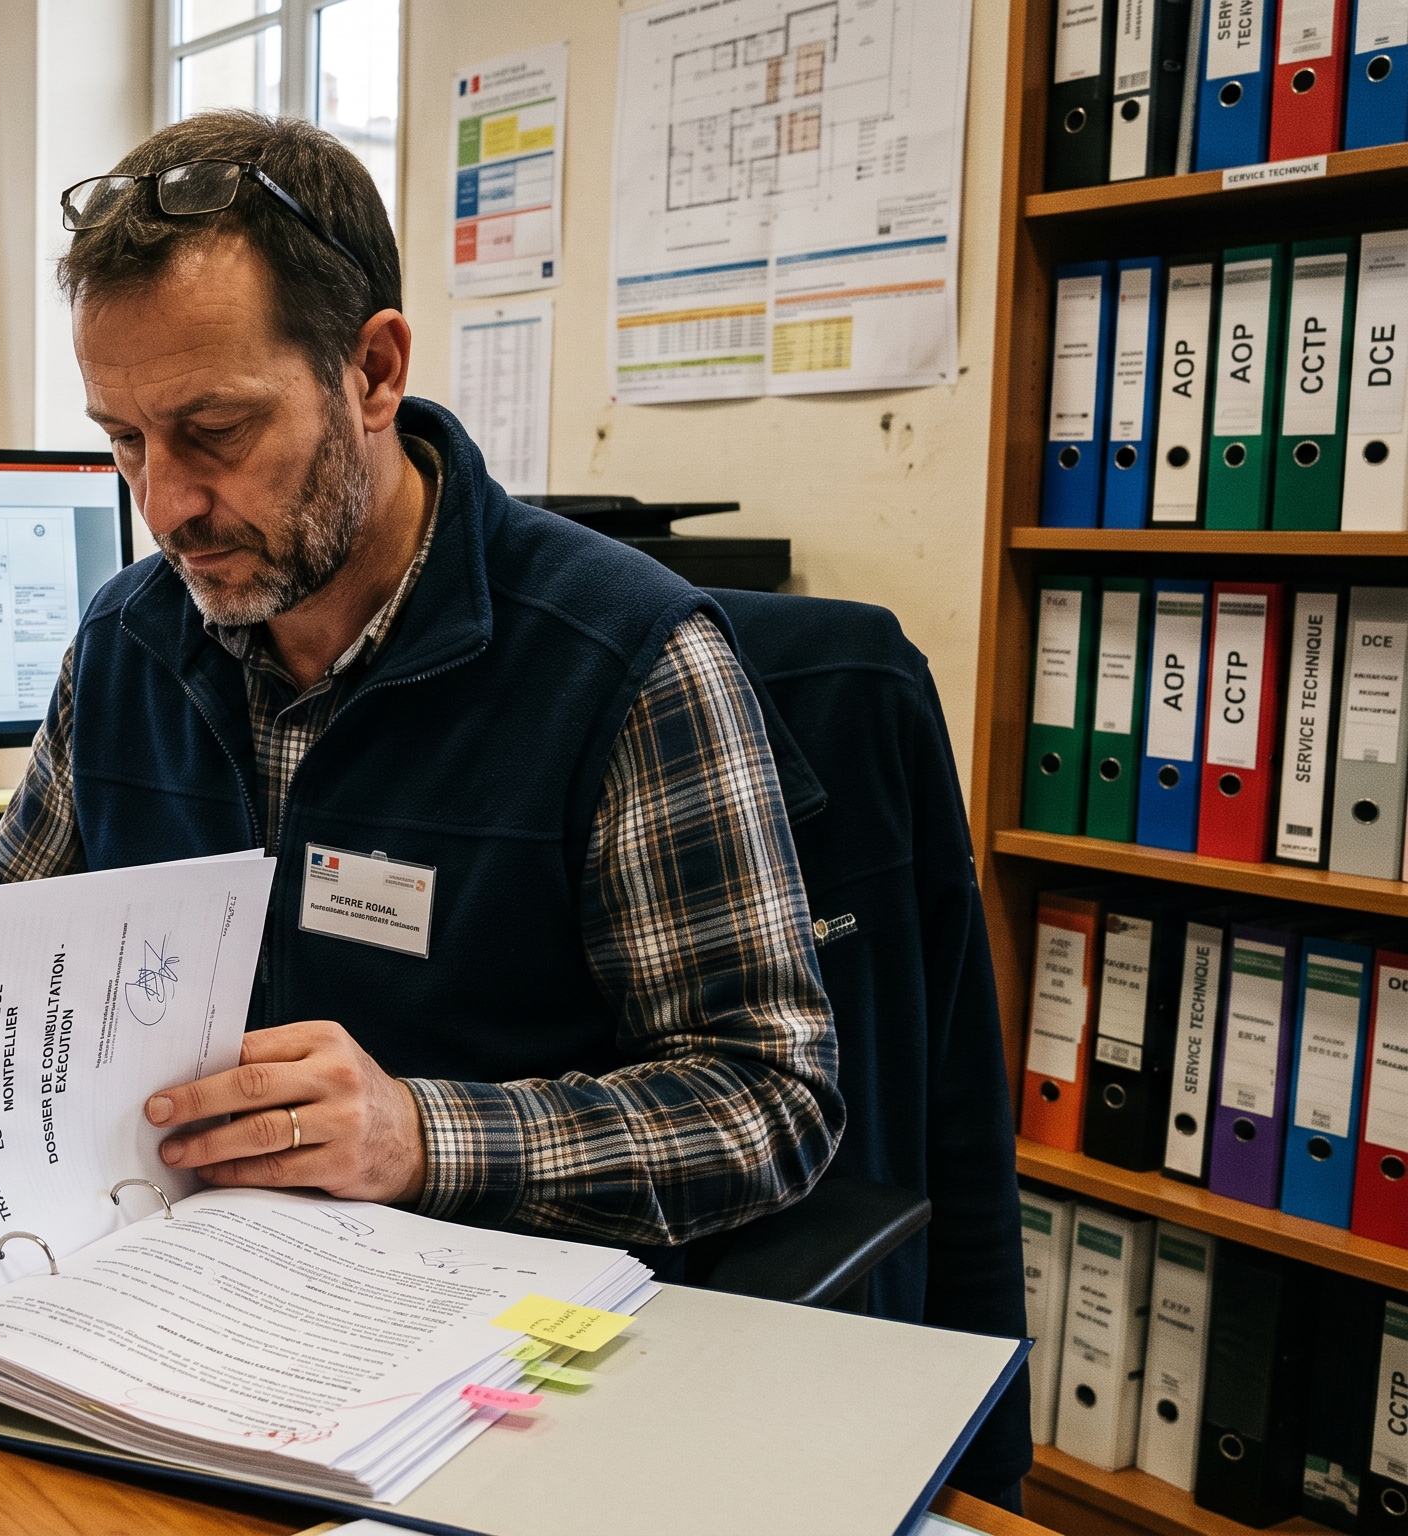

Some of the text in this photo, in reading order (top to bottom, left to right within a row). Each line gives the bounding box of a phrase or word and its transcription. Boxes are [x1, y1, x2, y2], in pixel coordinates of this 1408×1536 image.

[1228, 169, 1265, 183] SERVICE
[1172, 340, 1195, 398] AOP
[1230, 324, 1253, 383] AOP
[1300, 317, 1326, 394] CCTP
[1368, 324, 1395, 386] DCE
[1361, 634, 1393, 648] DCE
[1163, 653, 1185, 711] AOP
[1223, 651, 1248, 724] CCTP
[1296, 614, 1323, 783] SERVICE TECHNIQUE
[330, 894, 363, 909] PIERRE
[55, 1009, 74, 1093] EXÉCUTION
[1185, 945, 1210, 1094] SERVICE TECHNIQUE
[3, 1006, 18, 1112] MONTPELLIER
[41, 1073, 52, 1094] DE
[42, 1097, 59, 1164] DOSSIER
[1387, 1371, 1408, 1437] CCTP
